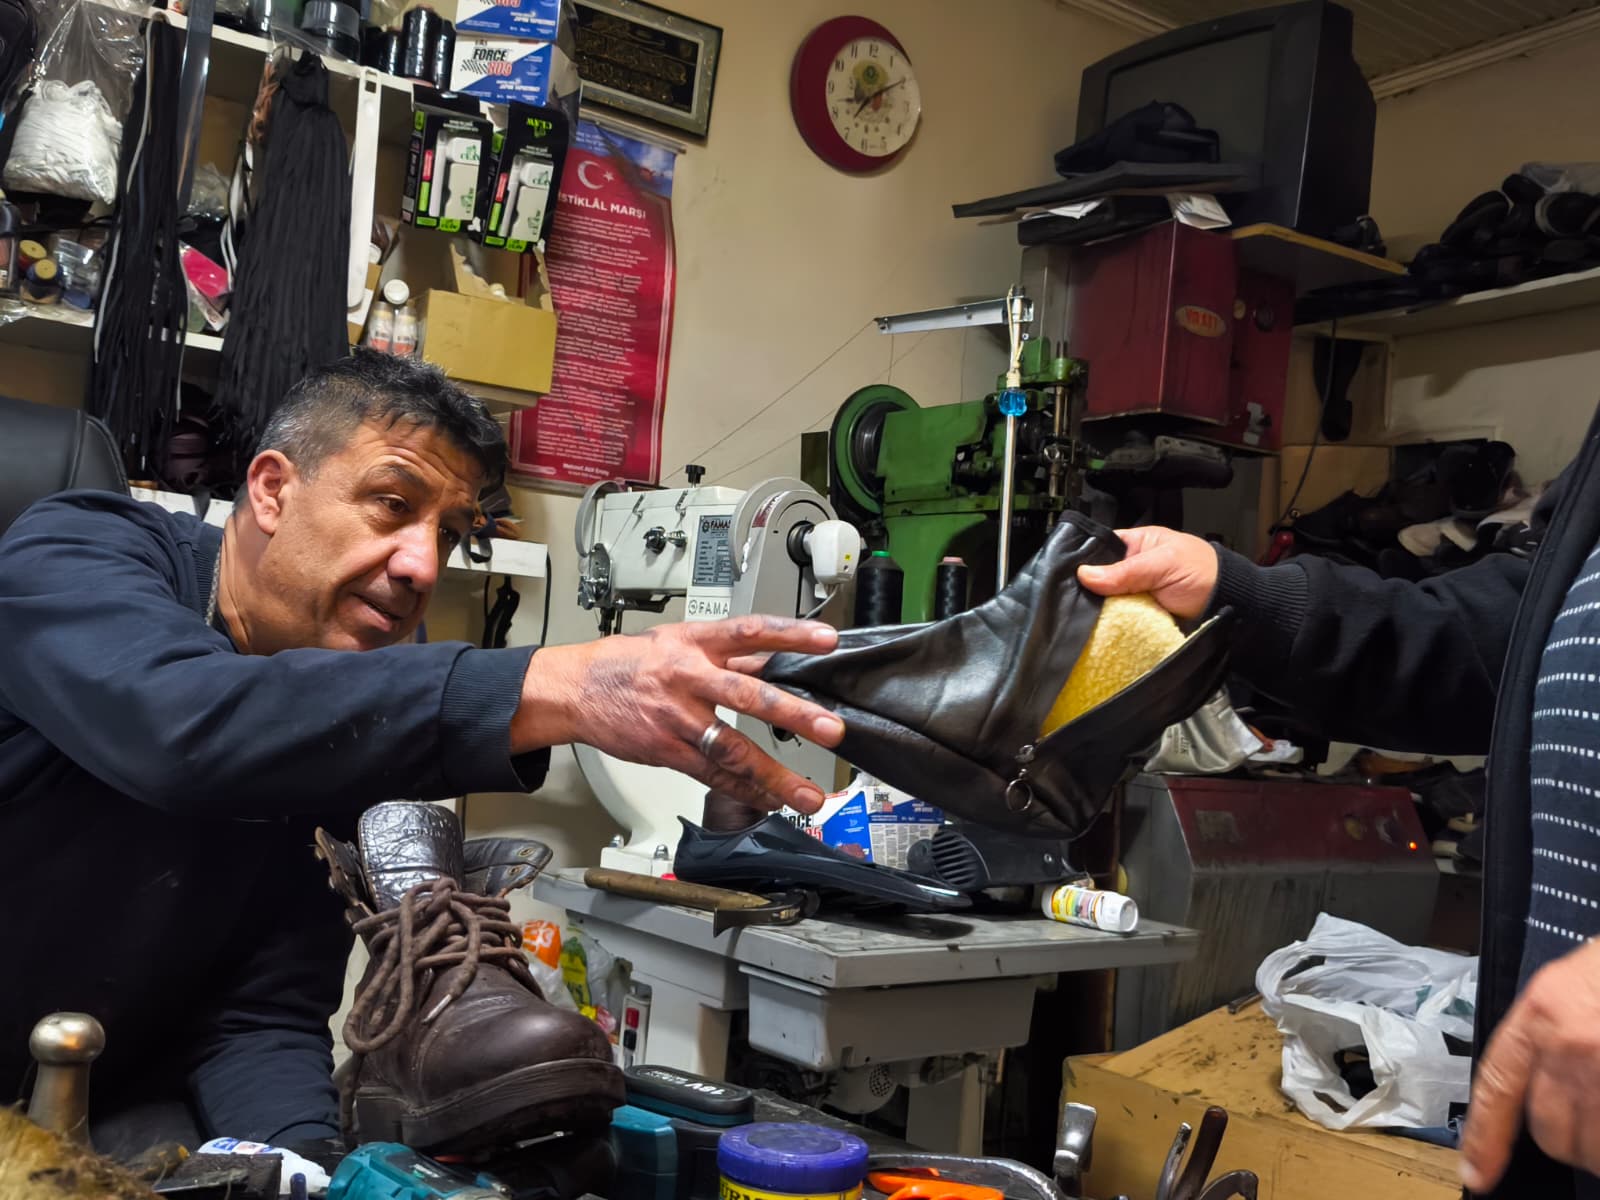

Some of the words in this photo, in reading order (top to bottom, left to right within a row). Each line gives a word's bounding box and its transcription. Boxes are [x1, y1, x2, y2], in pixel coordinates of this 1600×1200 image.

[473, 48, 508, 62] FORCE
[869, 43, 879, 58] 12
[487, 61, 513, 77] 809
[828, 81, 835, 93] 9
[831, 107, 838, 119] 8
[844, 127, 850, 141] 7
[880, 136, 888, 150] 5
[610, 202, 646, 220] MARŞI
[684, 1082, 726, 1095] 18V
